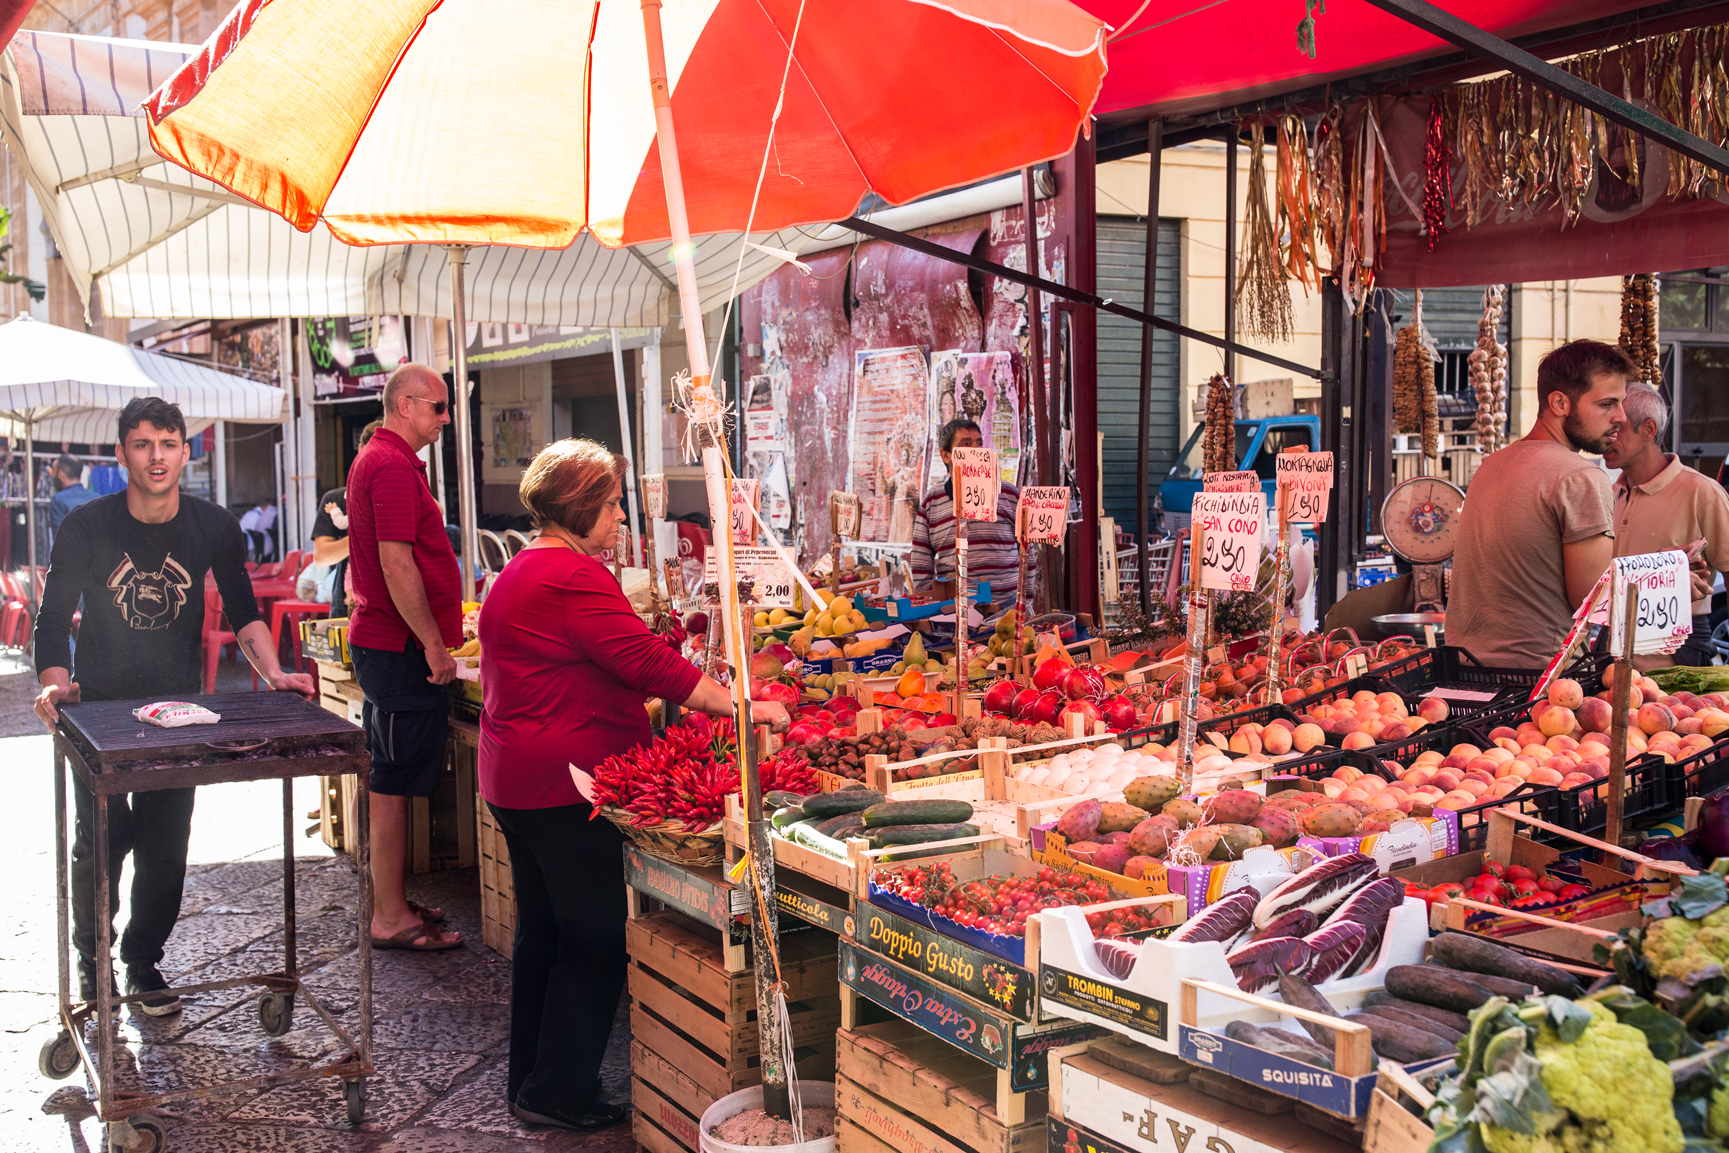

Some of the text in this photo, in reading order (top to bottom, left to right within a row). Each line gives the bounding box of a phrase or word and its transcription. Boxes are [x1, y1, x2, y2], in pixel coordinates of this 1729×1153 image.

[765, 585, 790, 598] 2,00
[871, 657, 897, 666] GRASSO
[775, 888, 831, 922] utticola
[869, 916, 975, 982] Doppio Gusto
[860, 963, 977, 1044] Extra Ortaggi
[1067, 974, 1141, 1011] TROMBIN STEFANO
[1073, 990, 1096, 1002] PRODOTTI
[1261, 1068, 1334, 1088] SQUISITA
